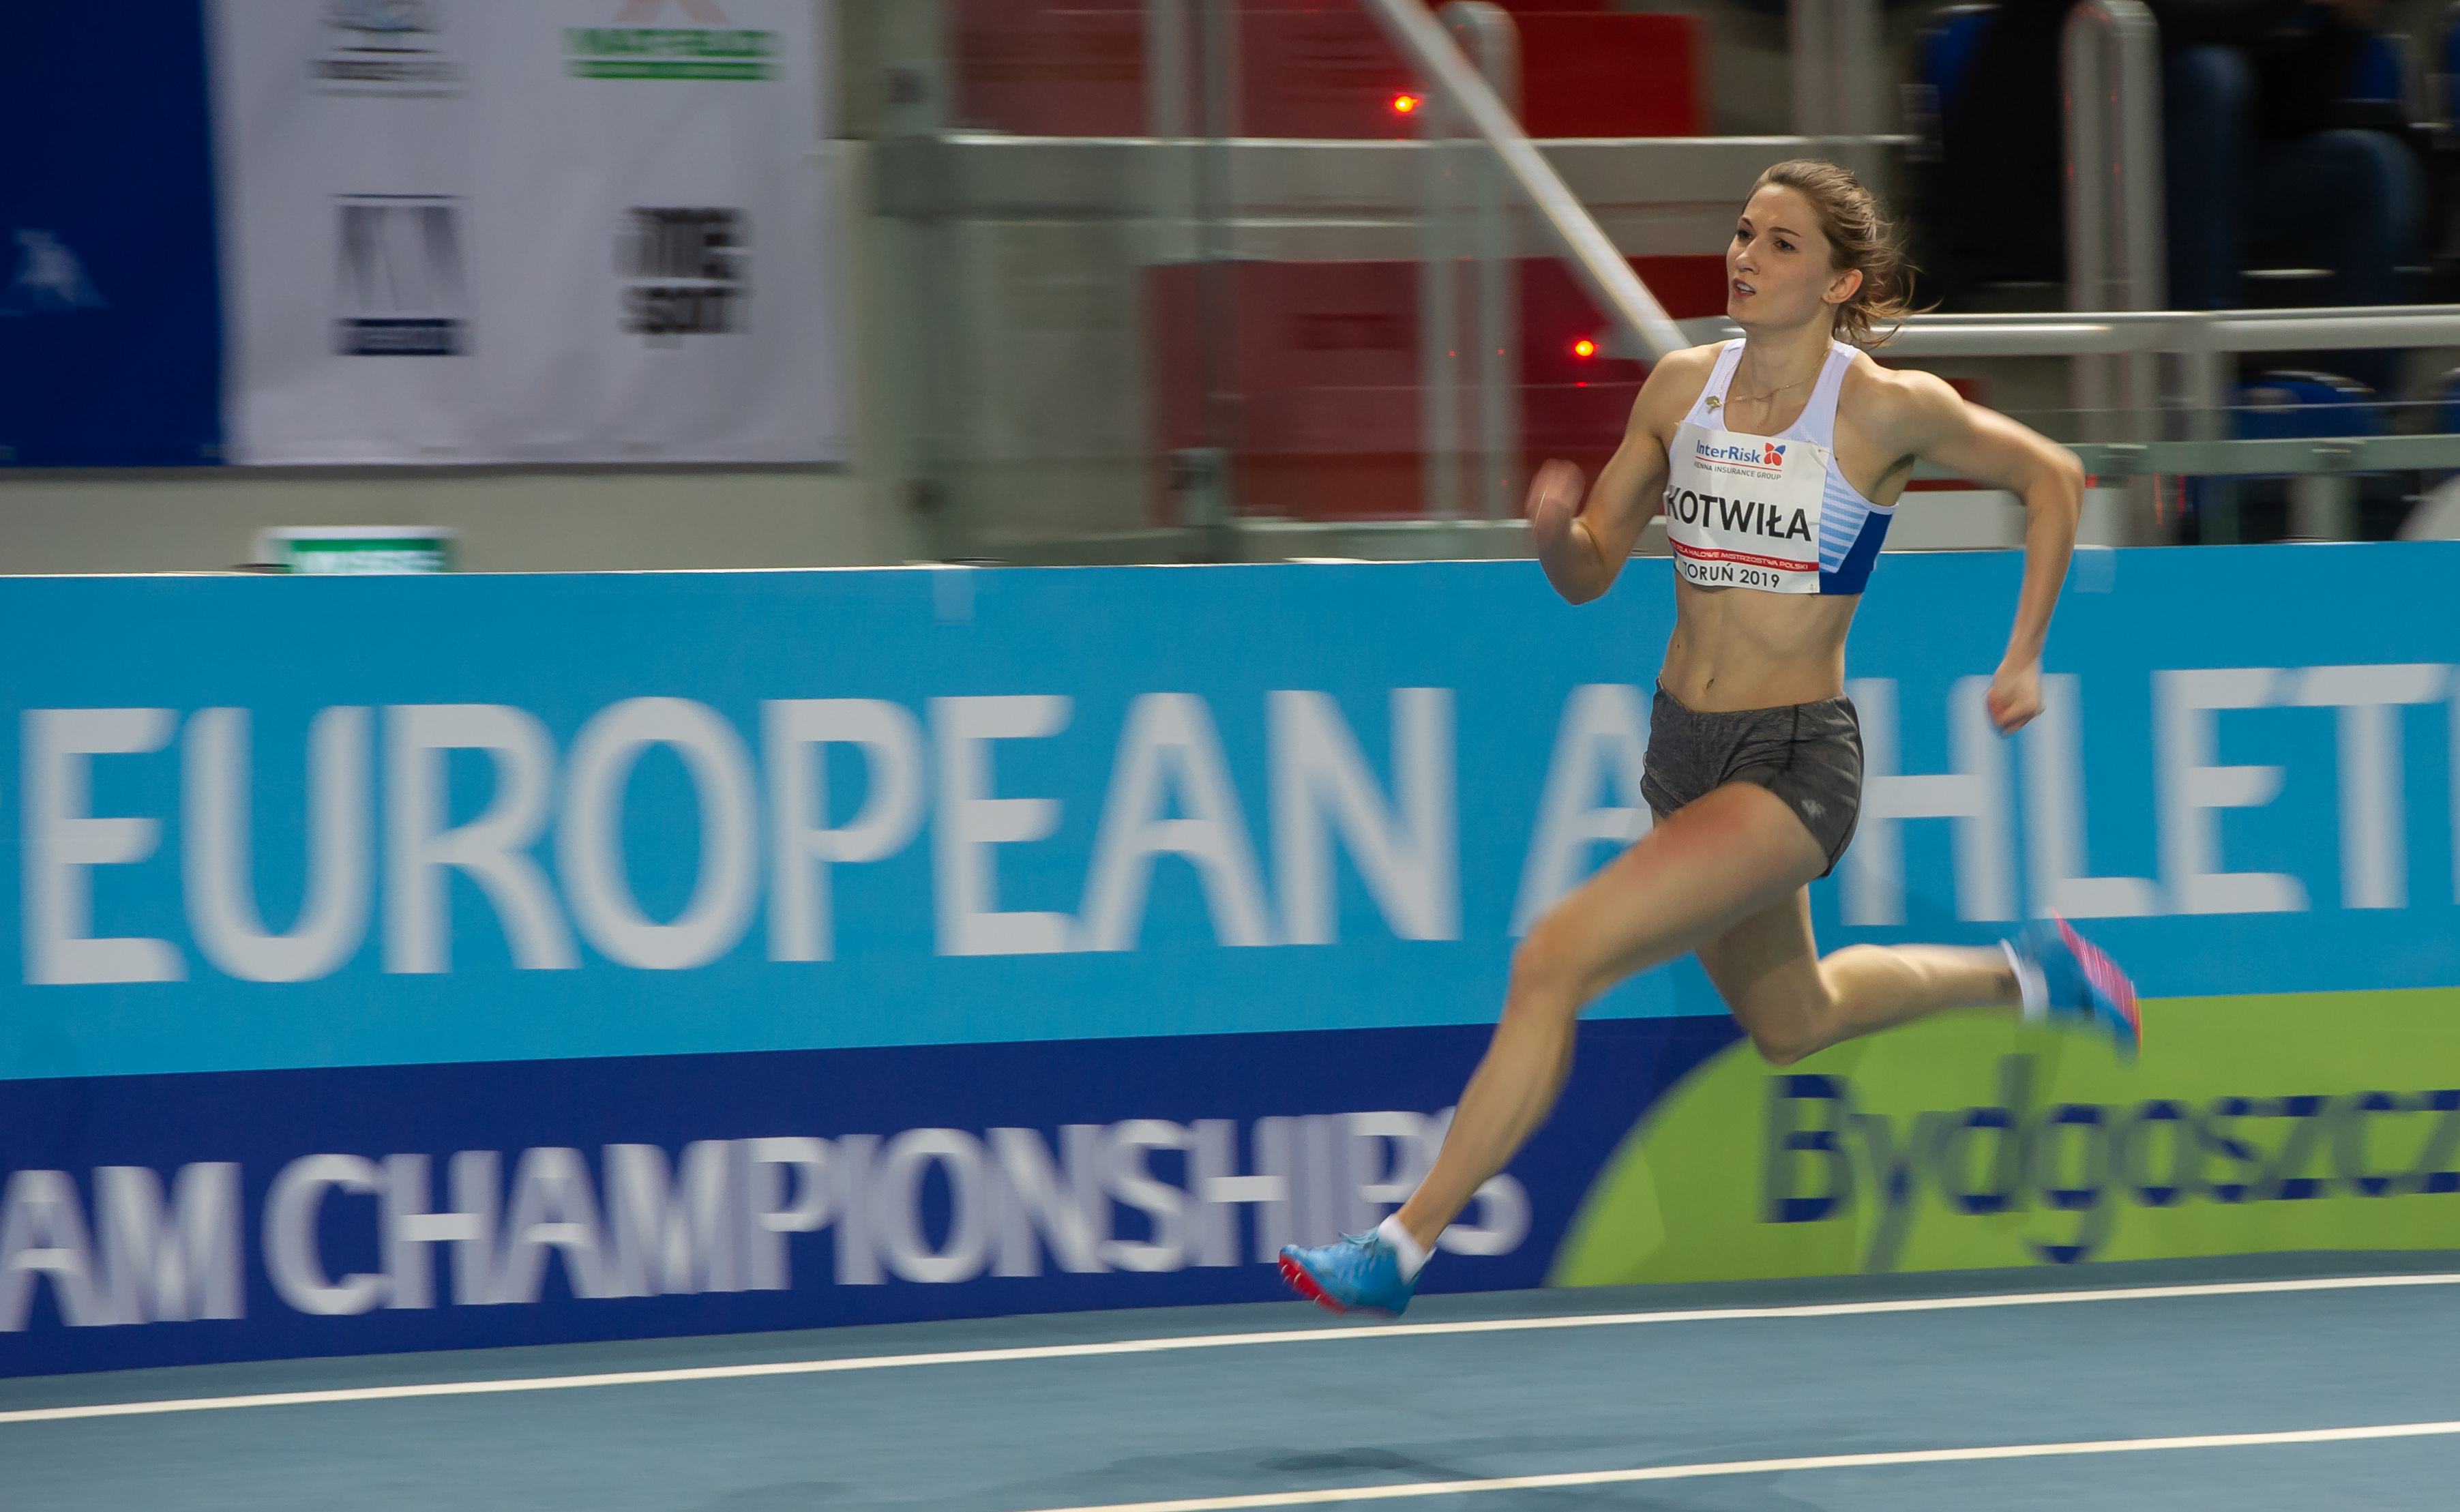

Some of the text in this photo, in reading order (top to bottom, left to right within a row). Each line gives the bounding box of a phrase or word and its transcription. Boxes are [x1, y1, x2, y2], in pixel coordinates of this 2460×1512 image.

[1696, 440, 1761, 464] InterRisk
[1715, 466, 1755, 477] INSURANCE
[1757, 471, 1781, 480] GROUP
[1667, 485, 1811, 542] KOTWIŁA
[1683, 563, 1780, 588] TORUŃ 2019
[1779, 561, 1809, 569] POLSKI
[19, 687, 1462, 985] EUROPEAN
